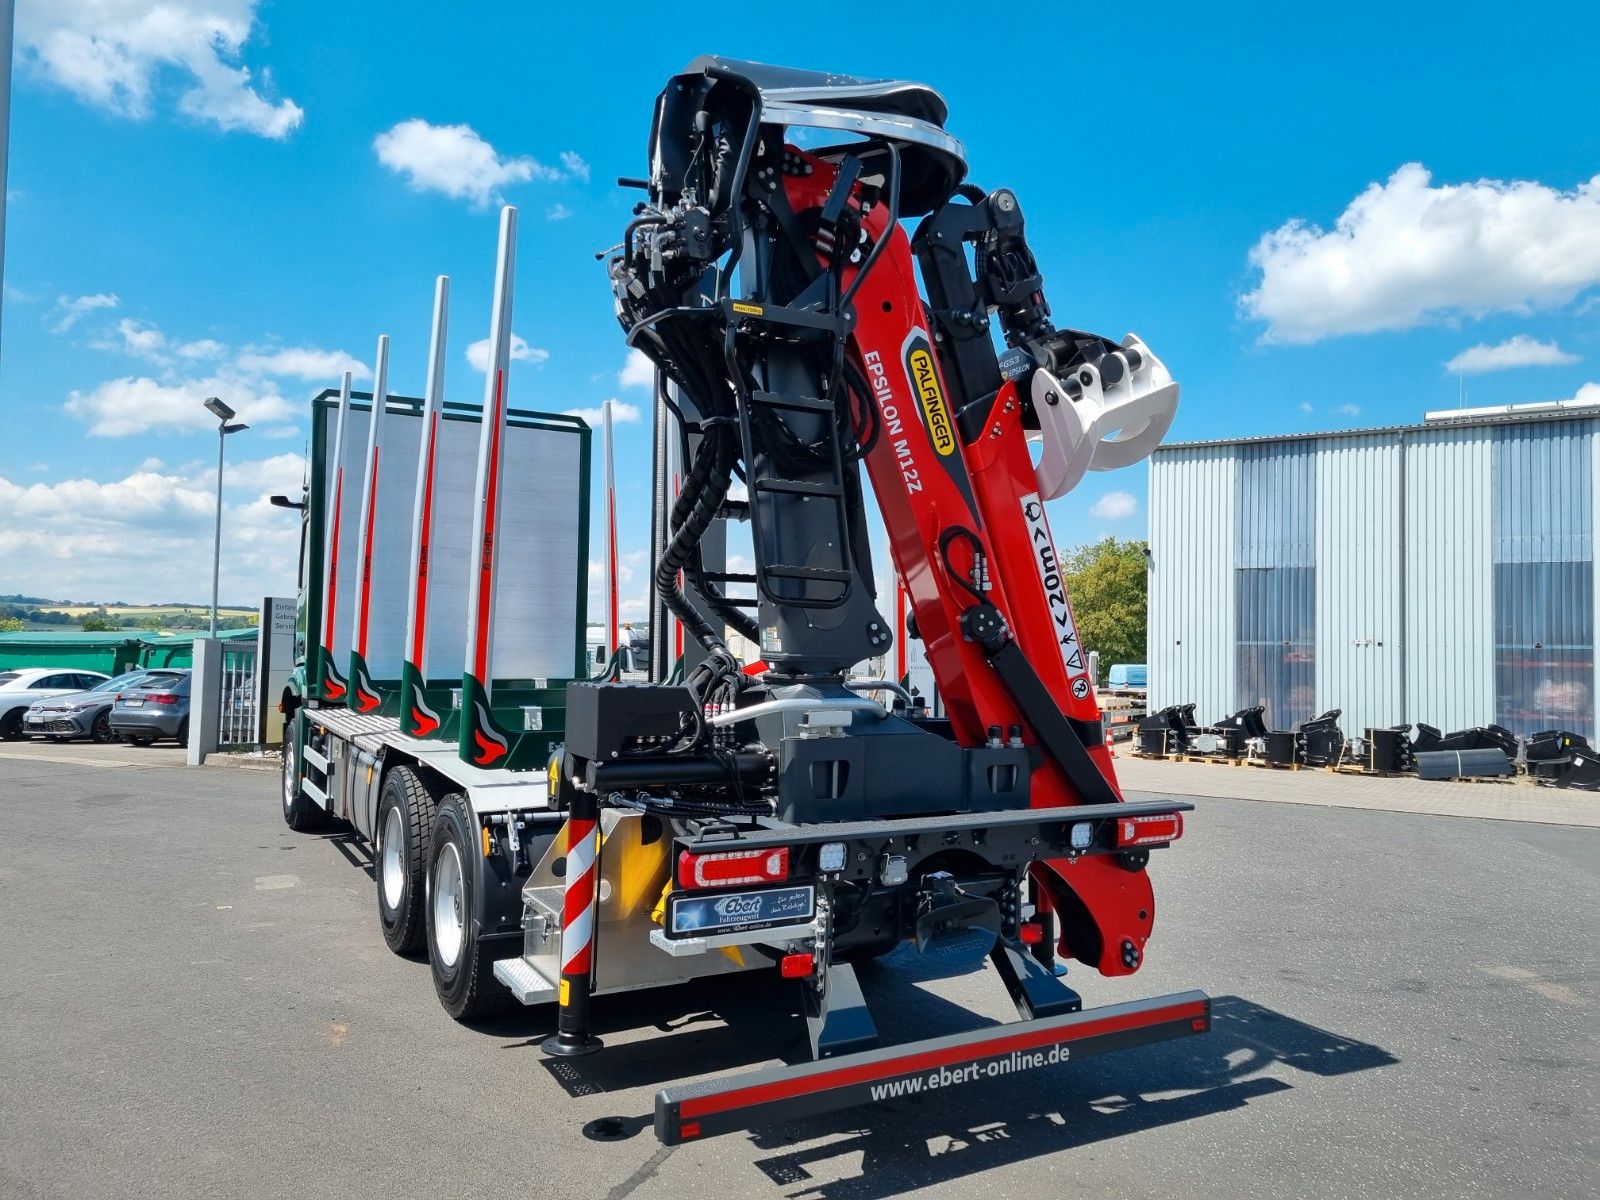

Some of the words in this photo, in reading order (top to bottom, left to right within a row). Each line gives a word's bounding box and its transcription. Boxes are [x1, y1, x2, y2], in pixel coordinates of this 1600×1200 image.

[864, 350, 904, 436] EPSILON
[893, 438, 923, 495] M12Z
[913, 355, 951, 449] PALFINGER
[719, 913, 760, 923] Fahrzeugwelt
[725, 898, 761, 914] Ebert
[870, 1044, 1070, 1102] www.ebert-online.de
